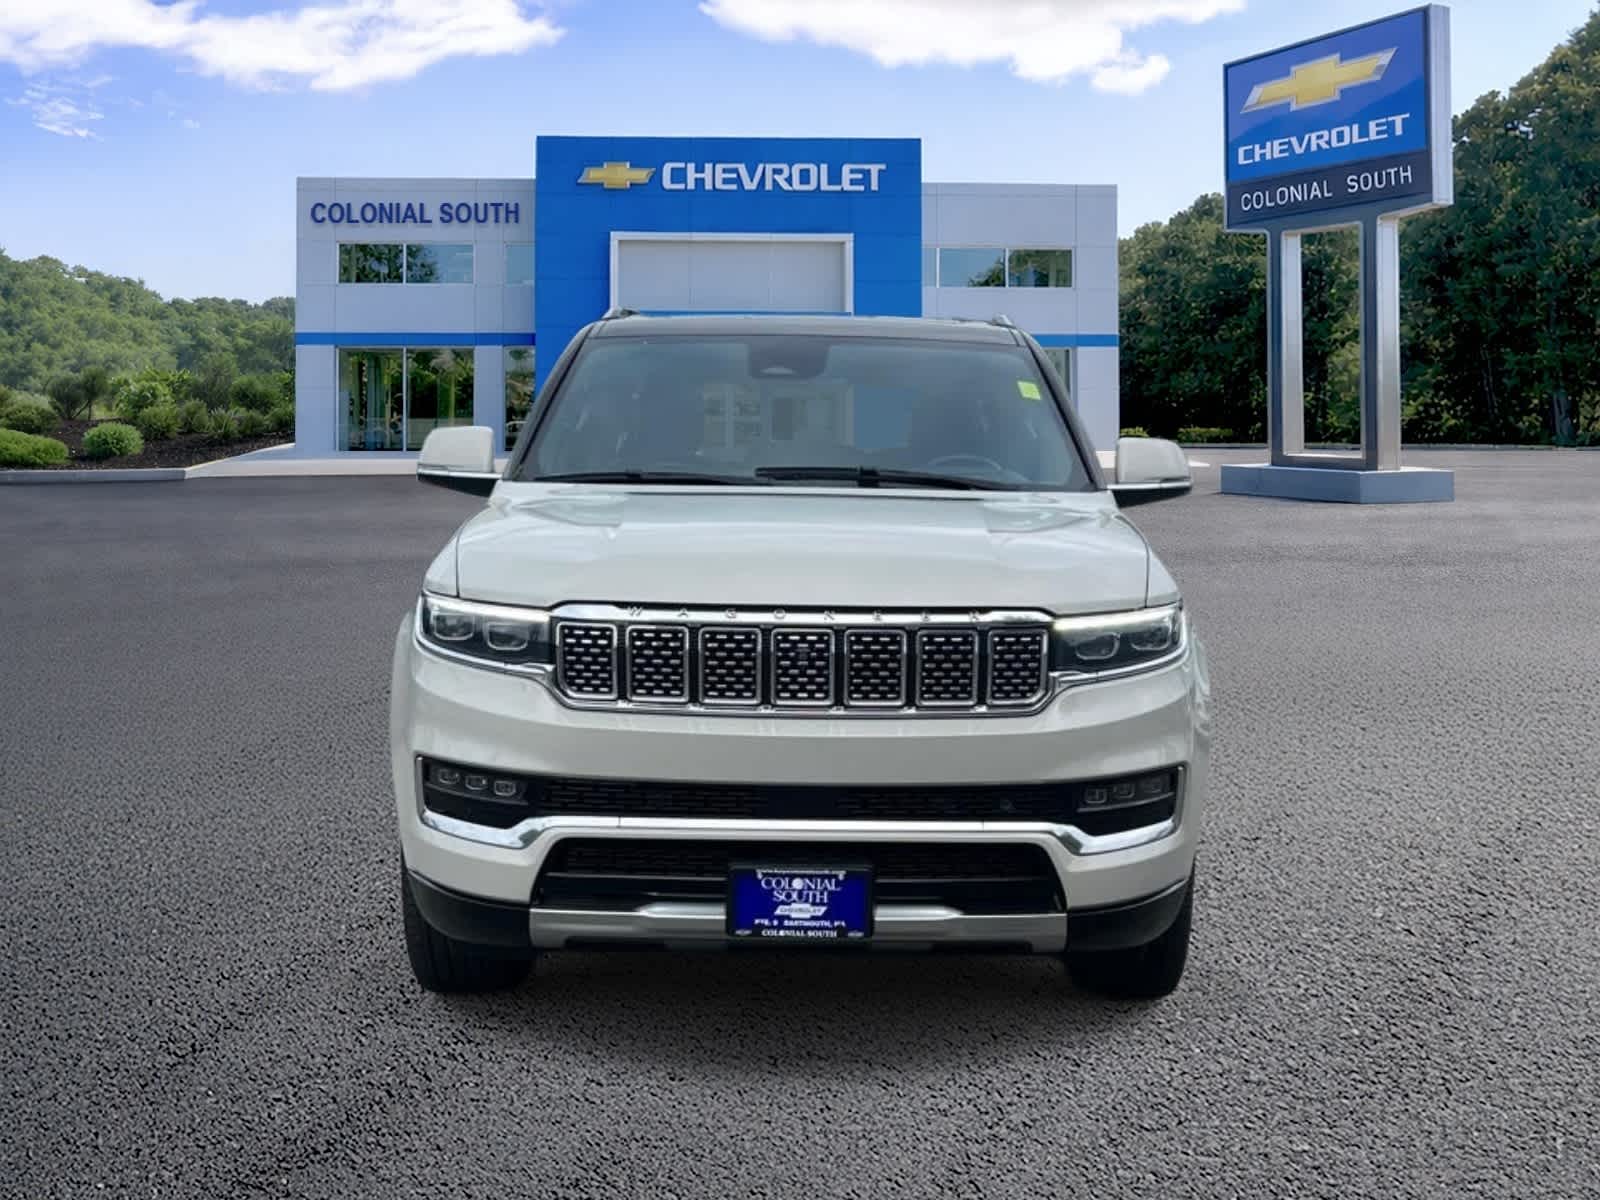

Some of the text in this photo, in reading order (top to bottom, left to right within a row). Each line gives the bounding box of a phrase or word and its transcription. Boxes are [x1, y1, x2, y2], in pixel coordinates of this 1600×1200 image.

[1237, 113, 1410, 165] CHEVROLET
[662, 162, 887, 191] CHEVROLET
[1241, 165, 1412, 211] COLONIAL SOUTH
[310, 202, 520, 224] COLONIAL SOUTH
[760, 877, 842, 891] COLONIAL
[772, 889, 828, 903] SOUTH
[761, 929, 805, 937] COLONIAL
[807, 930, 837, 938] SOUTH
